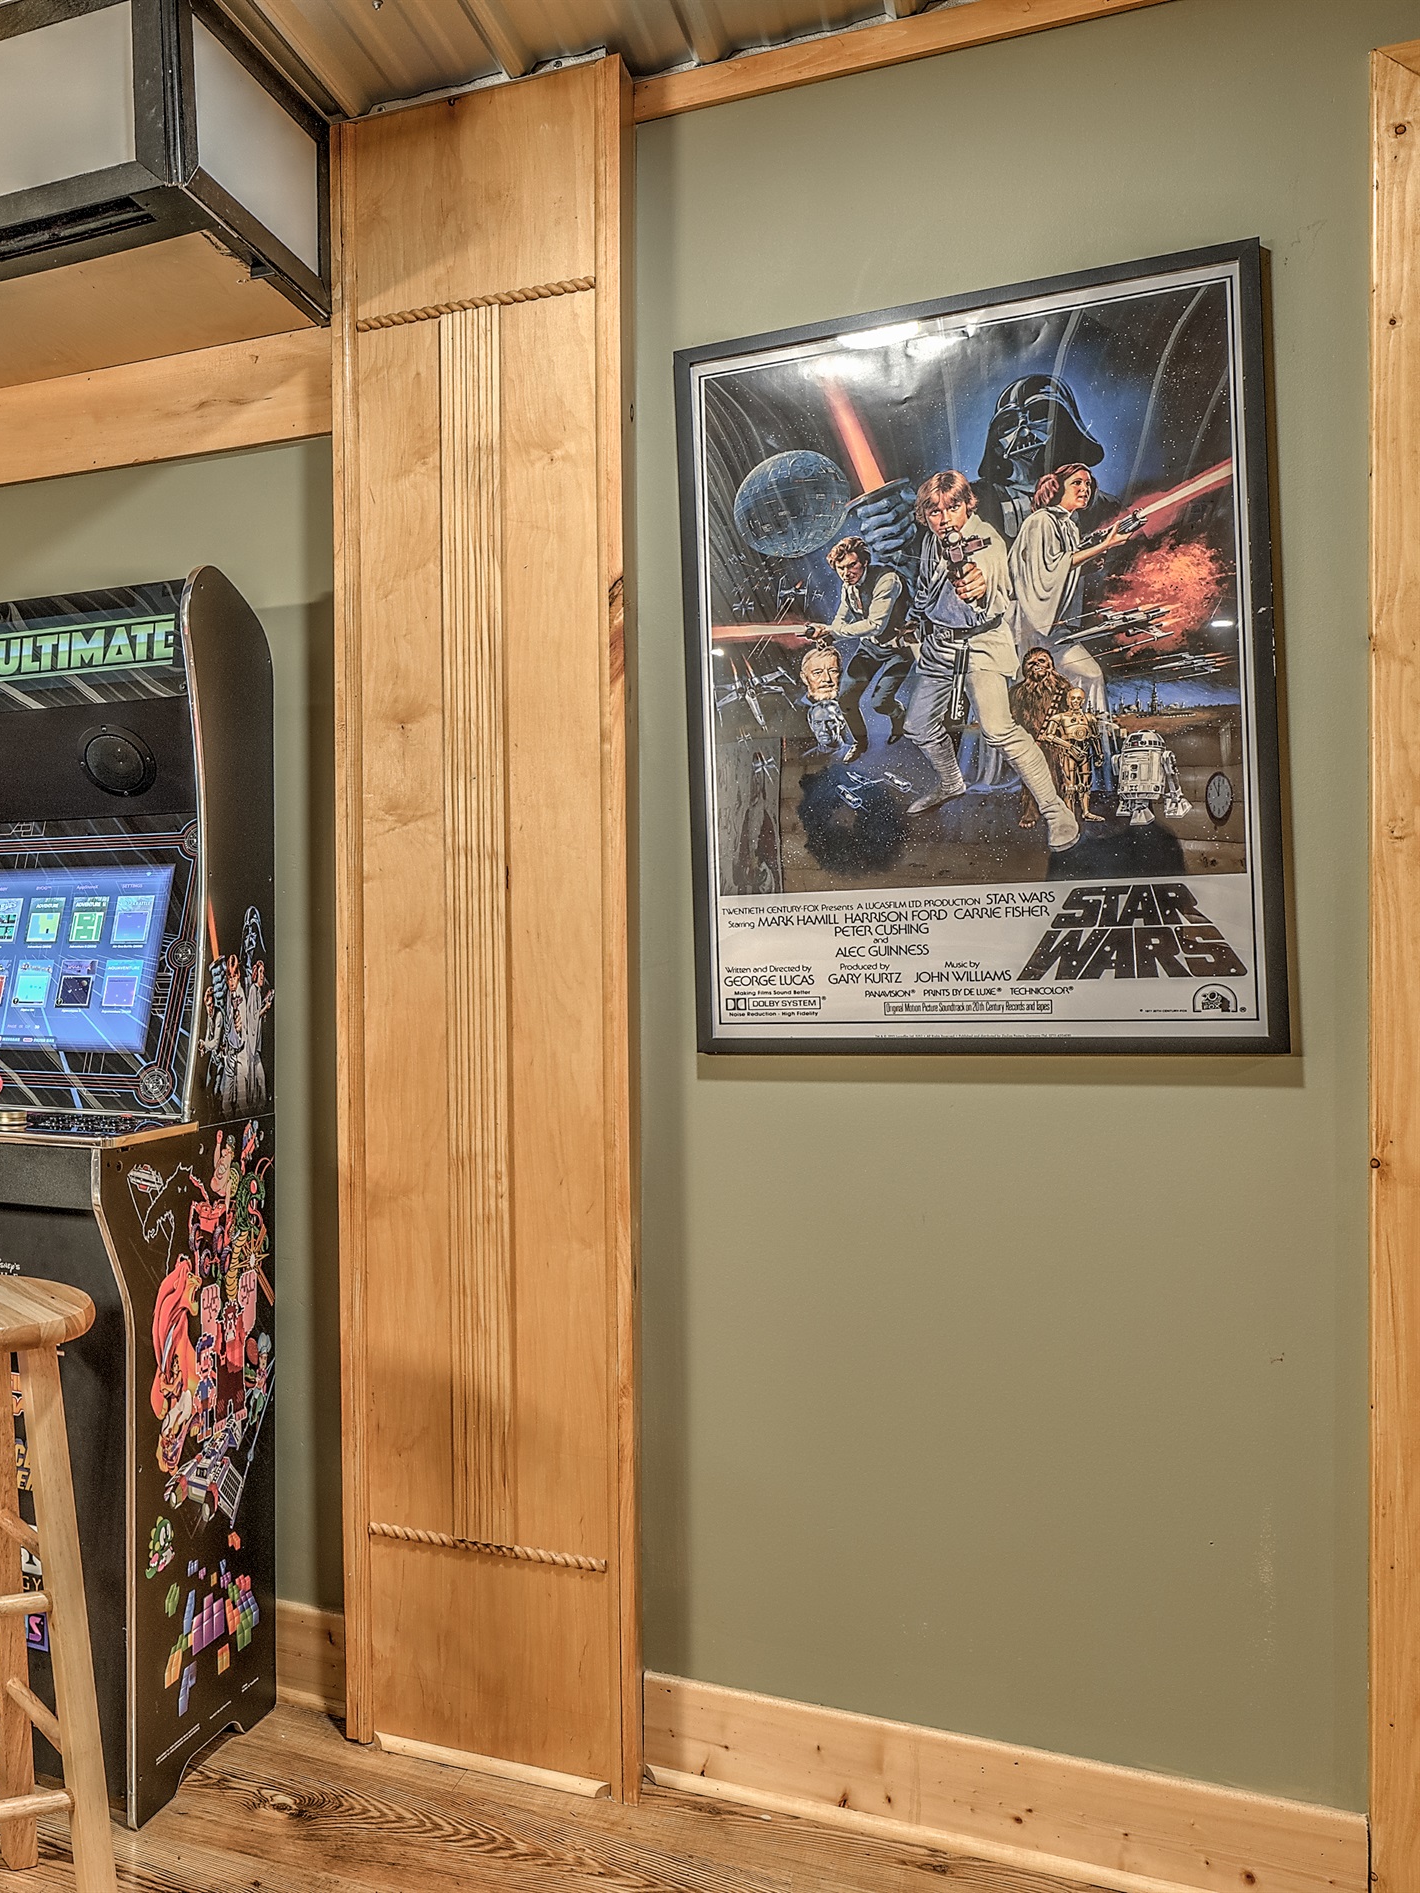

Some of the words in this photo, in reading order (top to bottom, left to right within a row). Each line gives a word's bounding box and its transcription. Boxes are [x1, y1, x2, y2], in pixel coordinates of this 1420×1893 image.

[722, 907, 765, 916] TWENTIETH
[767, 904, 820, 914] CENTURY-FOX
[821, 904, 854, 912] Presents
[865, 901, 907, 910] LUCASFILM
[924, 897, 981, 908] PRODUCTION
[986, 893, 1016, 905] STAR
[1018, 891, 1056, 904] WARS
[1051, 883, 1213, 929] STAR
[728, 920, 755, 929] Starring
[758, 915, 794, 927] MARK
[797, 913, 839, 926] HAMILL
[844, 910, 908, 924] HARRISON
[911, 908, 947, 921] FORD
[953, 905, 1002, 920] CARRIE
[1005, 905, 1051, 918] FISHER
[834, 925, 873, 937] PETER
[875, 923, 929, 936] CUSHING
[835, 946, 865, 958] ALEC
[868, 944, 930, 957] GUINNESS
[1016, 924, 1248, 981] WARS
[725, 966, 751, 974] Written
[769, 965, 800, 973] Directed
[802, 964, 812, 974] by
[840, 963, 877, 971] Produced
[879, 962, 890, 971] by
[944, 960, 968, 969] Music
[969, 960, 980, 969] by
[724, 975, 777, 987] GEORGE
[779, 974, 815, 986] LUCAS
[828, 973, 861, 984] GARY
[864, 972, 902, 984] KURTZ
[914, 971, 949, 983] JOHN
[952, 970, 1012, 982] WILLIAMS
[923, 988, 950, 997] PRINTS
[952, 988, 962, 996] BY
[964, 988, 975, 996] DE
[752, 1000, 780, 1008] DOLBY
[781, 999, 817, 1007] SYSTEM
[885, 1003, 903, 1014] Original
[904, 1002, 921, 1012] Motion
[922, 1002, 938, 1012] Picture
[939, 1002, 965, 1012] Soundtrack
[972, 1002, 984, 1011] 20th
[986, 1002, 1005, 1013] Century
[1005, 1002, 1025, 1011] Records
[1026, 1002, 1035, 1010] and
[1036, 1001, 1050, 1012] Tapes
